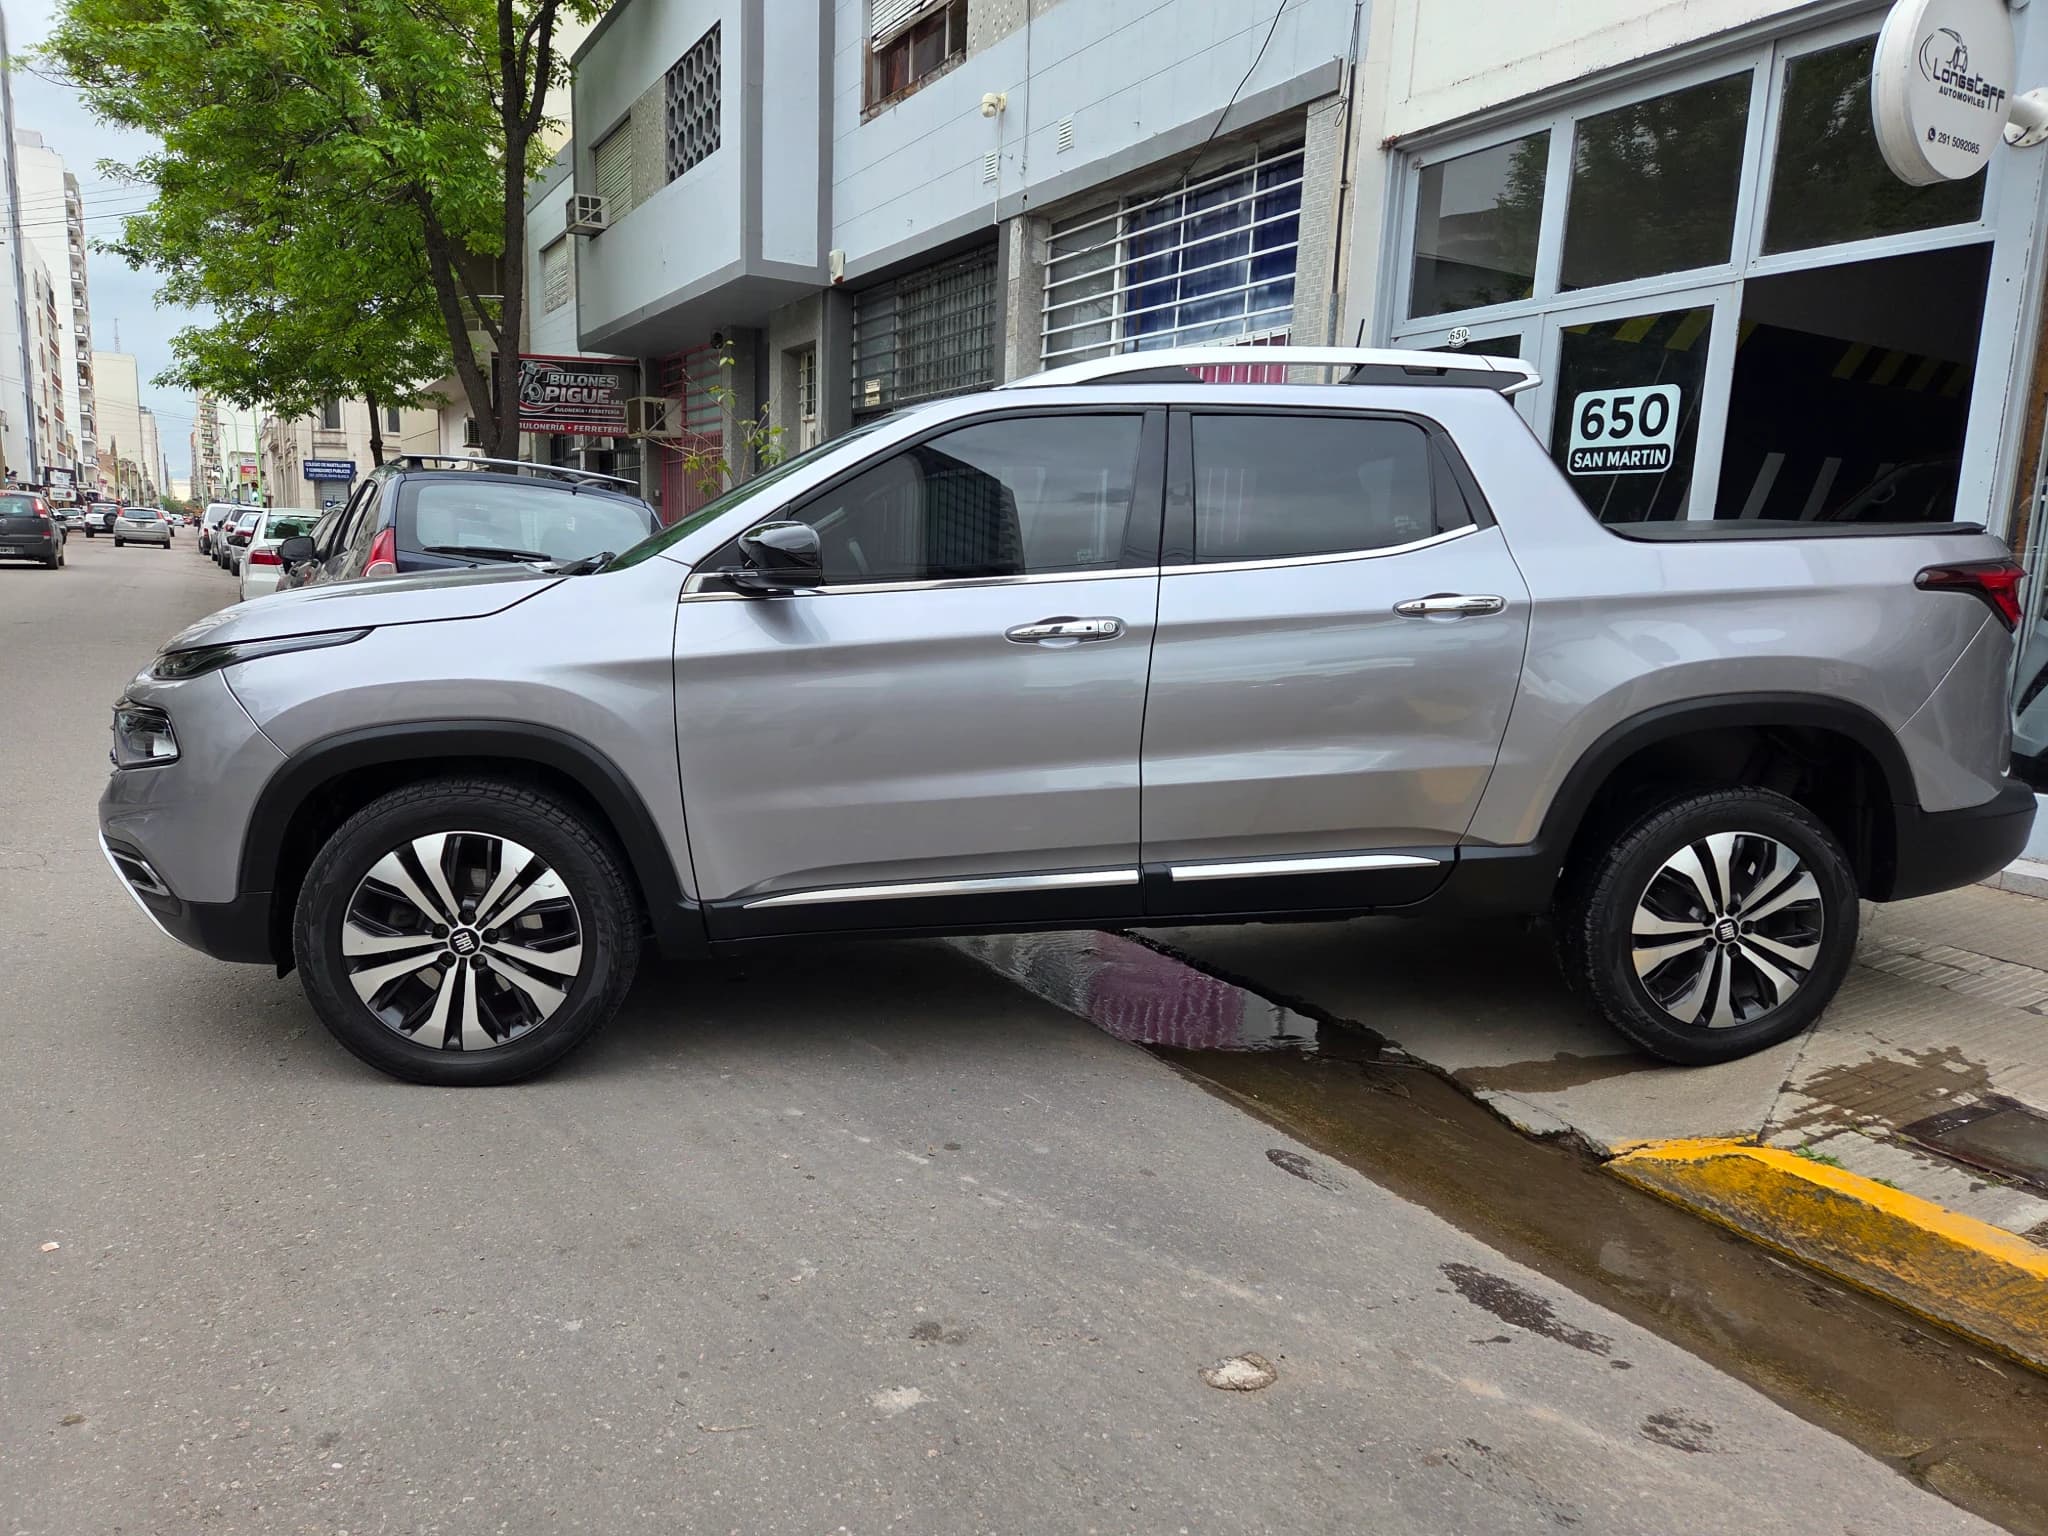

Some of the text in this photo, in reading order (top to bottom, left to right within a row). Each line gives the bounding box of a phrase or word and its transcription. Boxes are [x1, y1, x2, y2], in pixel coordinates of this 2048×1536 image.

[1938, 86, 1985, 109] AUTOMOVILES
[1937, 132, 1980, 154] 291 5092085
[1449, 328, 1467, 341] 650
[549, 374, 616, 387] BULONES
[1580, 392, 1670, 440] 650
[1573, 448, 1667, 468] SAN MARTIN
[1719, 921, 1736, 940] FIAT
[453, 931, 475, 953] FIAT
